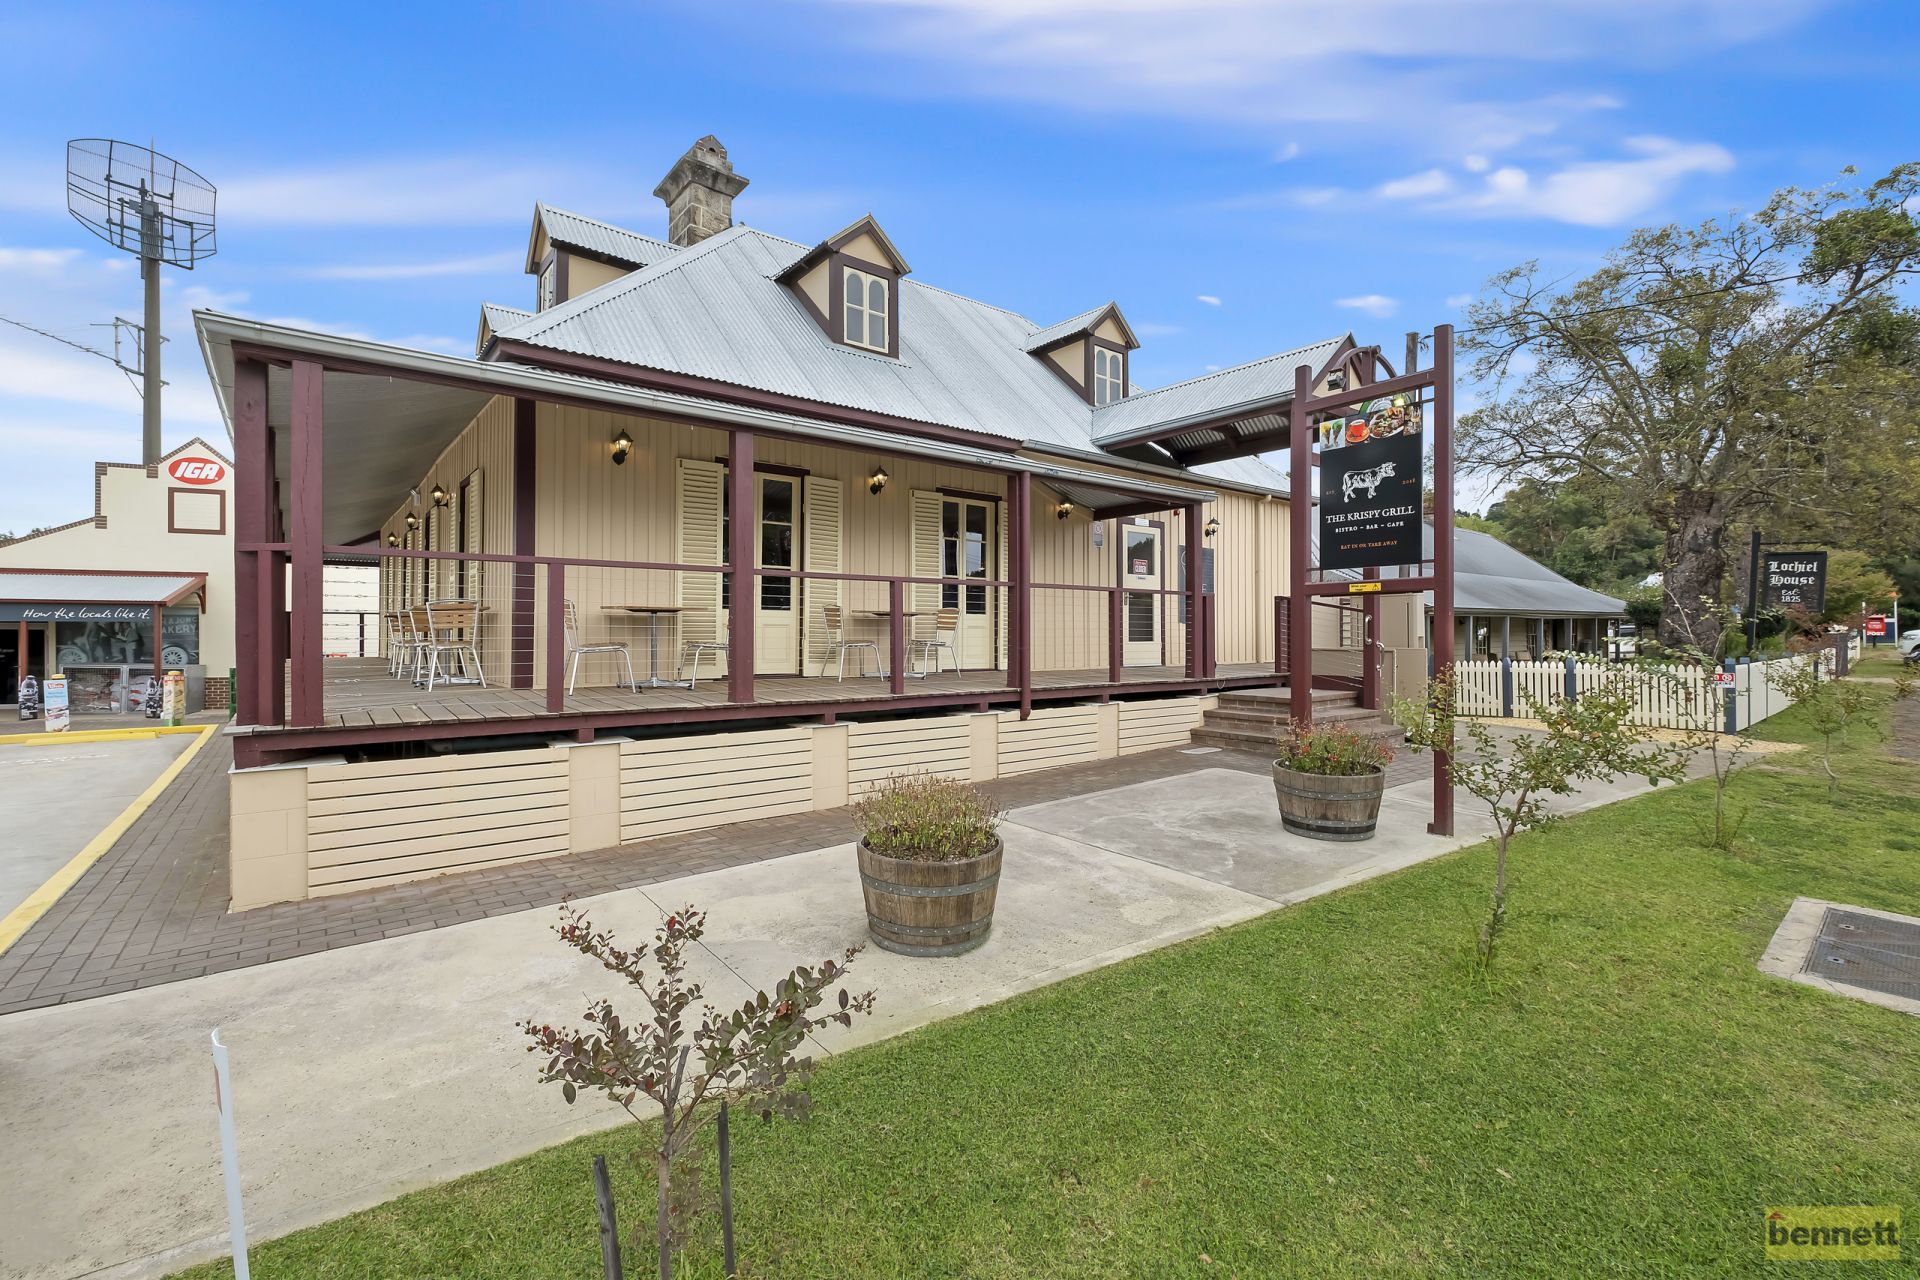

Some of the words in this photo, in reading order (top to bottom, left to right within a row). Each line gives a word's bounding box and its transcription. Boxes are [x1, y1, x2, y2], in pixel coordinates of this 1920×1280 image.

[173, 461, 220, 480] IGA
[1325, 514, 1346, 523] THE
[1347, 509, 1381, 521] KRISPY
[1381, 505, 1415, 517] GRILL
[1767, 561, 1818, 573] Lochiel
[1769, 574, 1815, 586] House
[1781, 595, 1801, 603] 1825
[23, 608, 52, 618] How
[54, 607, 75, 619] the
[78, 606, 111, 618] locals
[114, 607, 136, 618] like
[137, 608, 151, 619] it.
